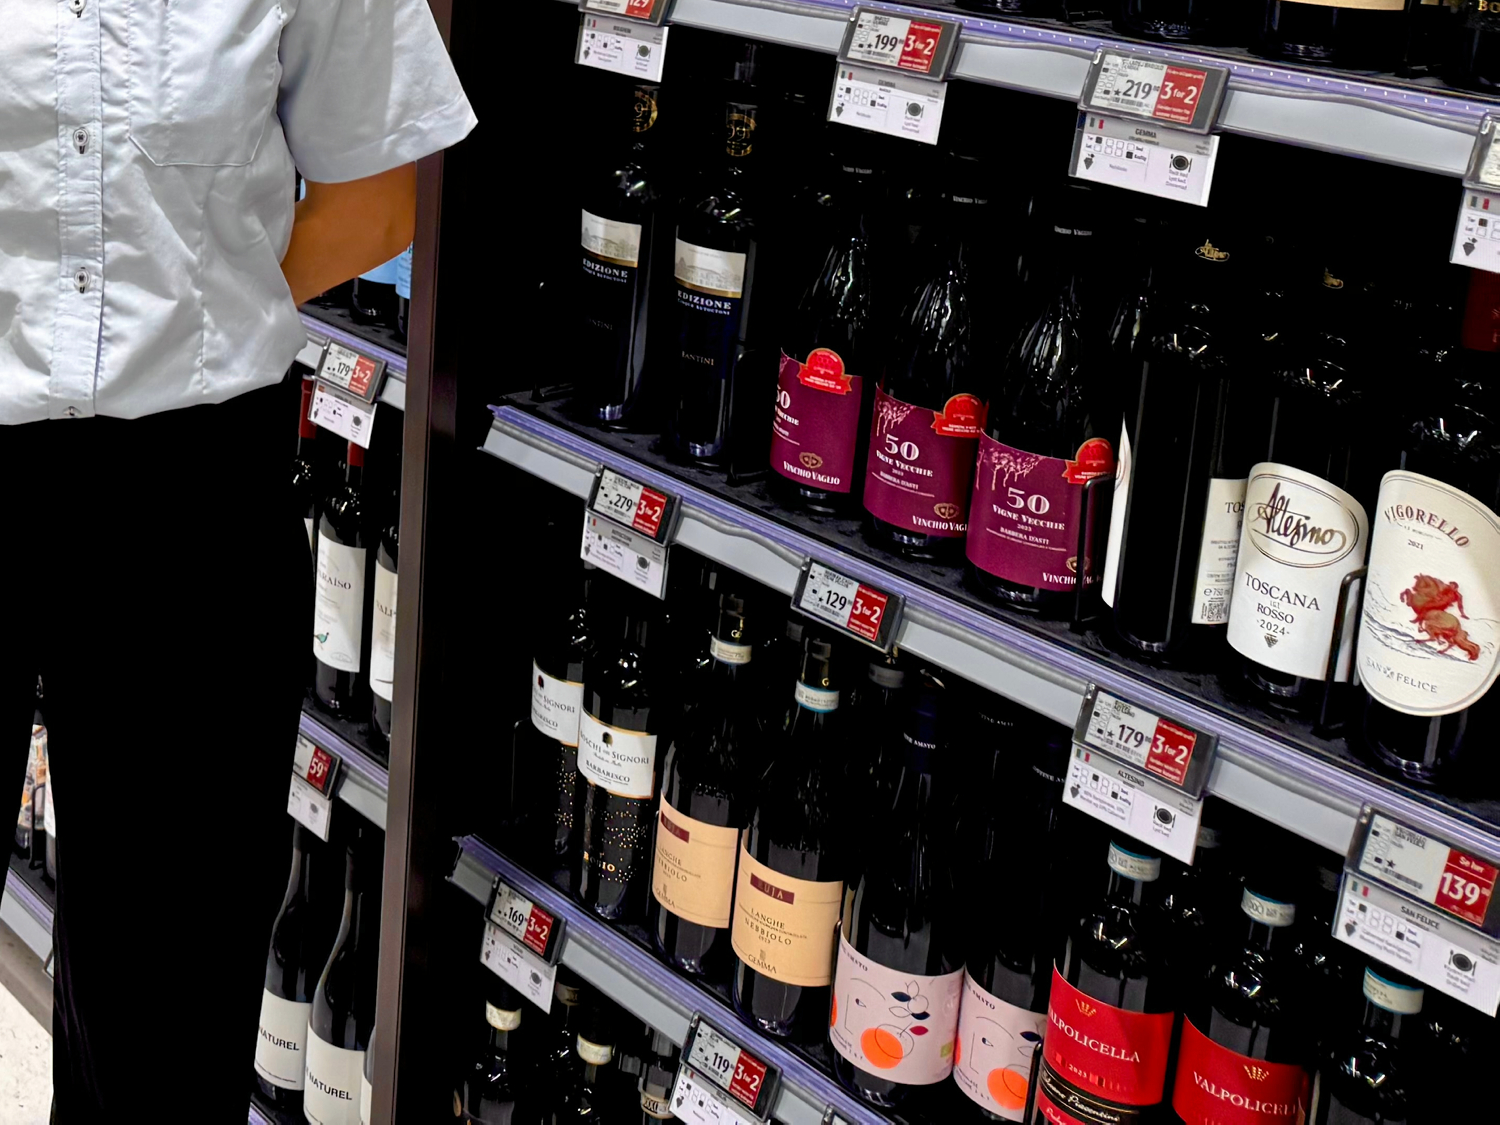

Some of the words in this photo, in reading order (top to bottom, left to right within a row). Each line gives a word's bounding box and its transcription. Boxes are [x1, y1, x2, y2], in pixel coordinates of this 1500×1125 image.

[874, 34, 898, 52] 199
[904, 35, 916, 51] 3
[923, 39, 935, 55] 2
[1123, 79, 1152, 100] 219
[1160, 82, 1174, 100] 3
[1173, 88, 1185, 98] for
[1183, 86, 1197, 105] 2
[583, 258, 628, 278] EDIZIONE
[677, 290, 732, 310] EDIZIONE
[353, 366, 360, 378] 3
[363, 370, 370, 383] 2
[884, 434, 920, 461] 50
[812, 471, 840, 485] VAGLIO
[895, 459, 933, 478] VECCHIE
[614, 494, 633, 512] 279
[637, 500, 647, 515] 3
[651, 506, 661, 522] 2
[1006, 486, 1050, 515] 50
[912, 515, 948, 530] VINCHIO
[992, 504, 1019, 521] VIGNE
[1021, 514, 1065, 530] VECCHIE
[1384, 504, 1471, 549] VIGORELLO
[1407, 539, 1424, 551] 2021
[1245, 572, 1321, 611] TOSCANA
[826, 590, 847, 611] 129
[852, 597, 863, 615] 3
[870, 606, 880, 624] 2
[1257, 603, 1294, 624] ROSSO
[1366, 656, 1382, 672] SAN
[1396, 672, 1438, 693] FELICE
[543, 695, 575, 713] SIGNORI
[1118, 724, 1144, 748] 179
[1152, 734, 1165, 754] 3
[1164, 745, 1176, 756] for
[1175, 745, 1189, 765] 2
[309, 757, 324, 777] 59
[611, 751, 649, 764] SIGNORI
[586, 760, 630, 783] BARBARESCO
[1442, 872, 1480, 905] 139
[509, 907, 523, 926] 169
[527, 917, 536, 931] 3
[539, 925, 548, 940] 2
[750, 908, 785, 929] LANGHE
[1401, 906, 1415, 919] SAN
[744, 917, 792, 946] NEBBIOLO
[747, 954, 777, 974] GEMMA
[713, 1052, 730, 1073] 119
[734, 1063, 745, 1080] 3
[742, 1073, 752, 1083] for
[749, 1075, 760, 1091] 2
[309, 1073, 353, 1101] NATUREL
